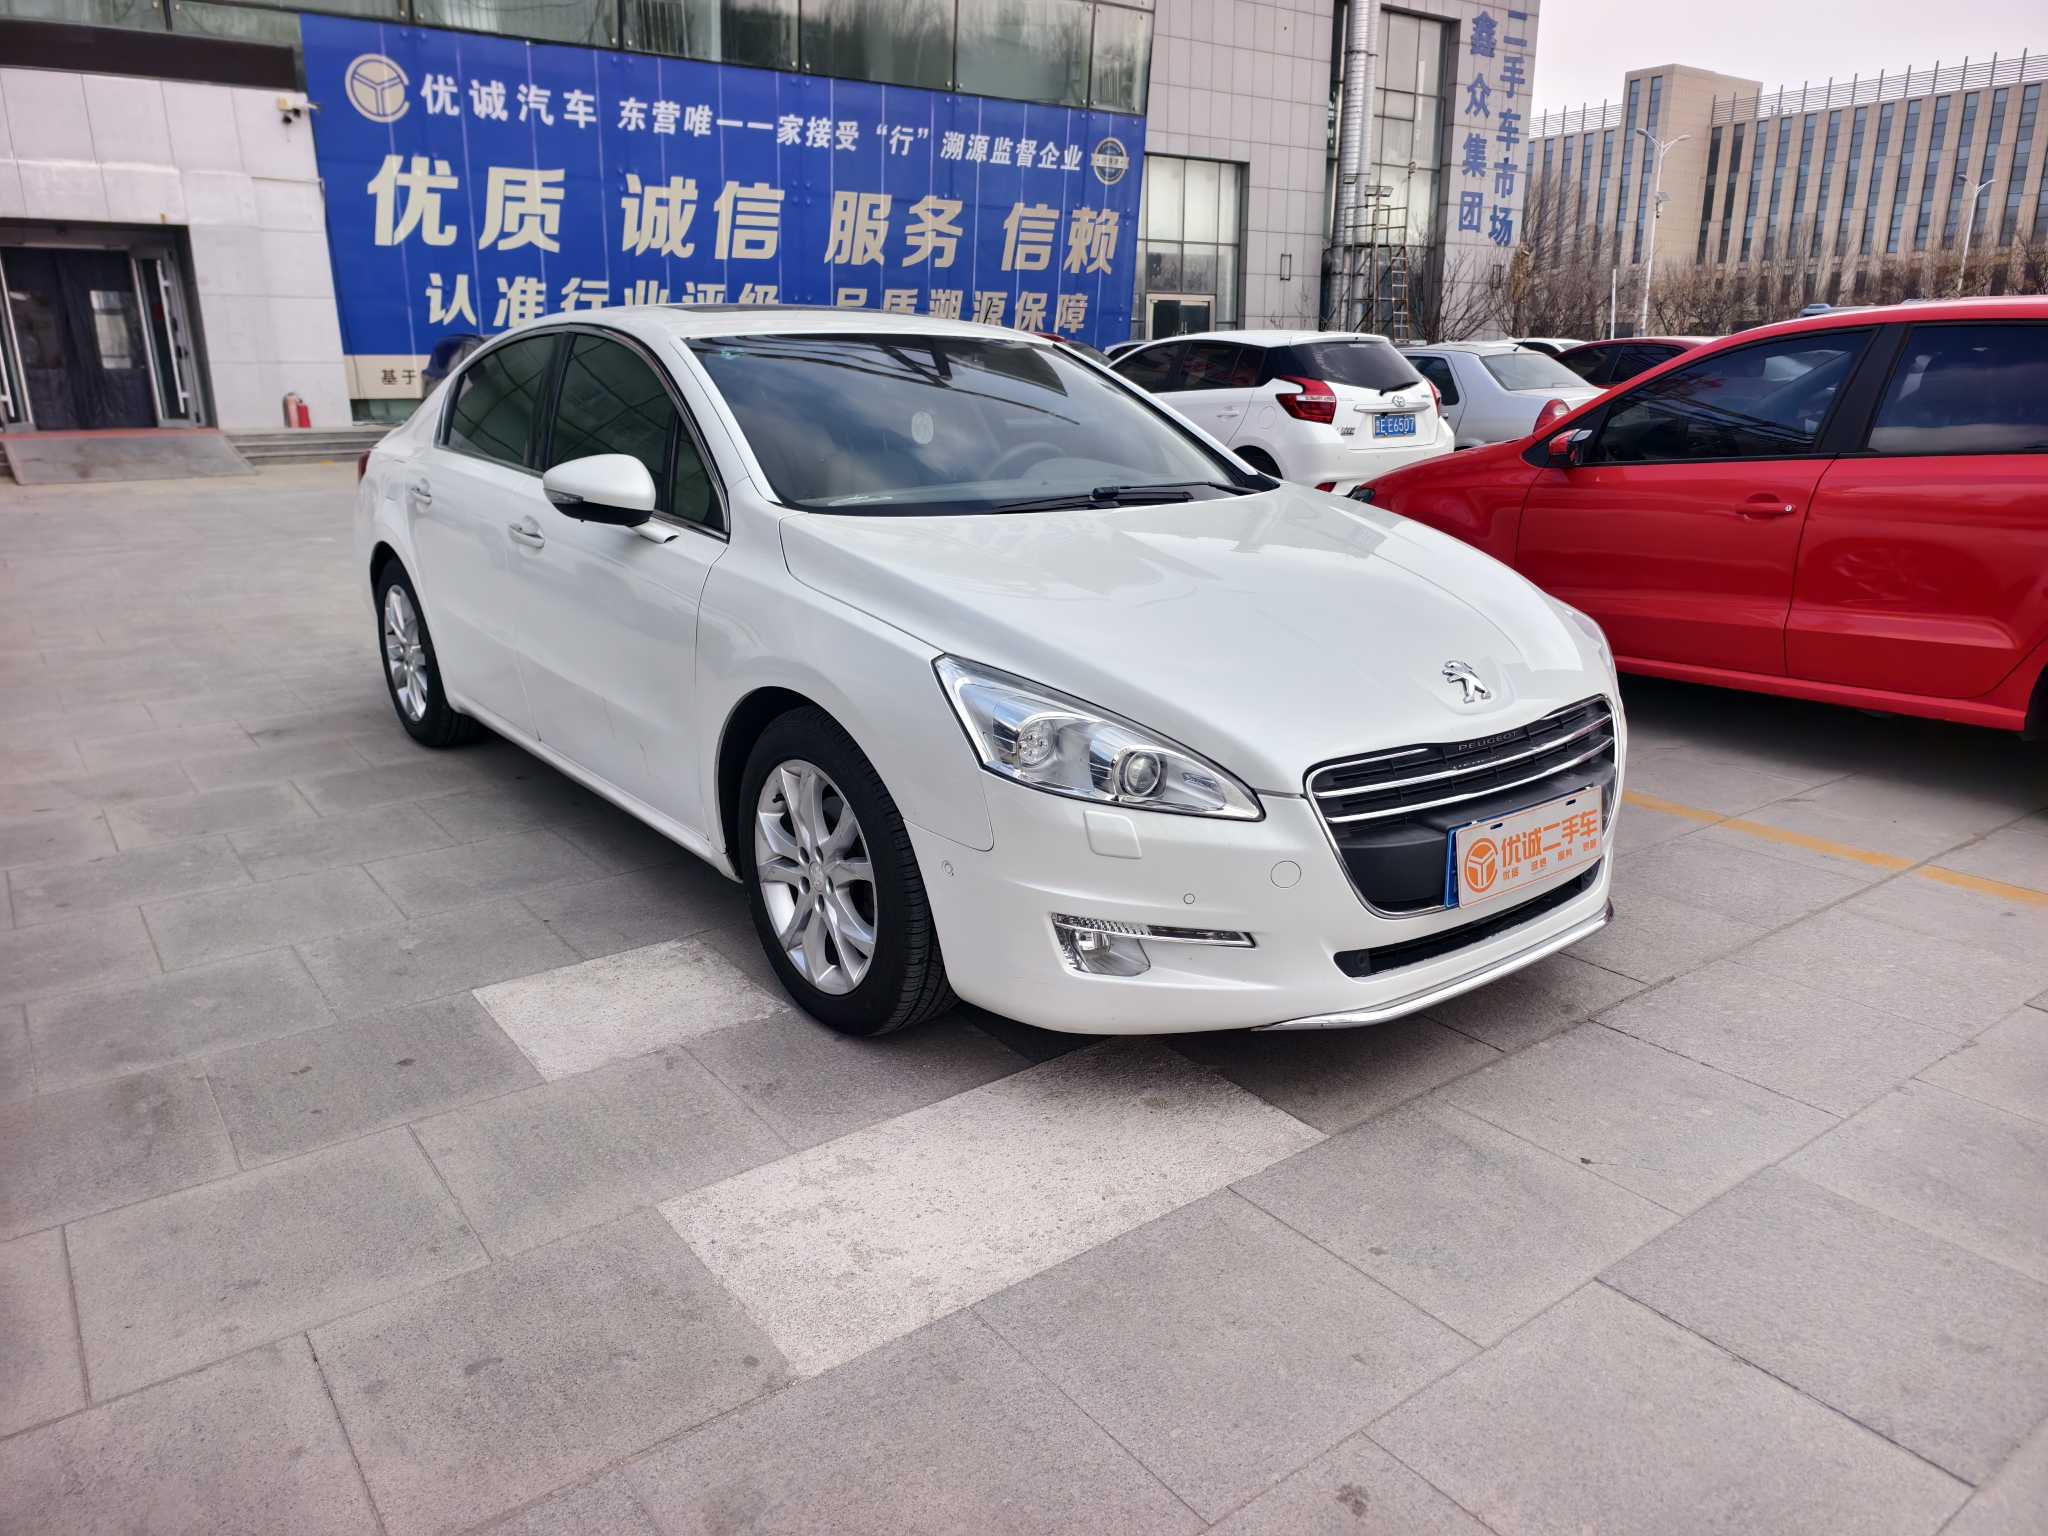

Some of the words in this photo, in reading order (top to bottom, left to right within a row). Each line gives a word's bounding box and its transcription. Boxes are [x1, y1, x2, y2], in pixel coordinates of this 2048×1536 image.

[421, 73, 597, 129] 优诚汽车
[1458, 10, 1497, 233] 鑫众集团
[1488, 10, 1528, 248] 二手车市场
[367, 153, 566, 254] 优质
[620, 173, 785, 260] 诚信
[824, 190, 963, 268] 服务
[1001, 201, 1120, 275] 信赖
[381, 368, 417, 385] 基于
[1458, 731, 1518, 751] PEUGEOT
[1501, 809, 1598, 867] 优诚二手车
